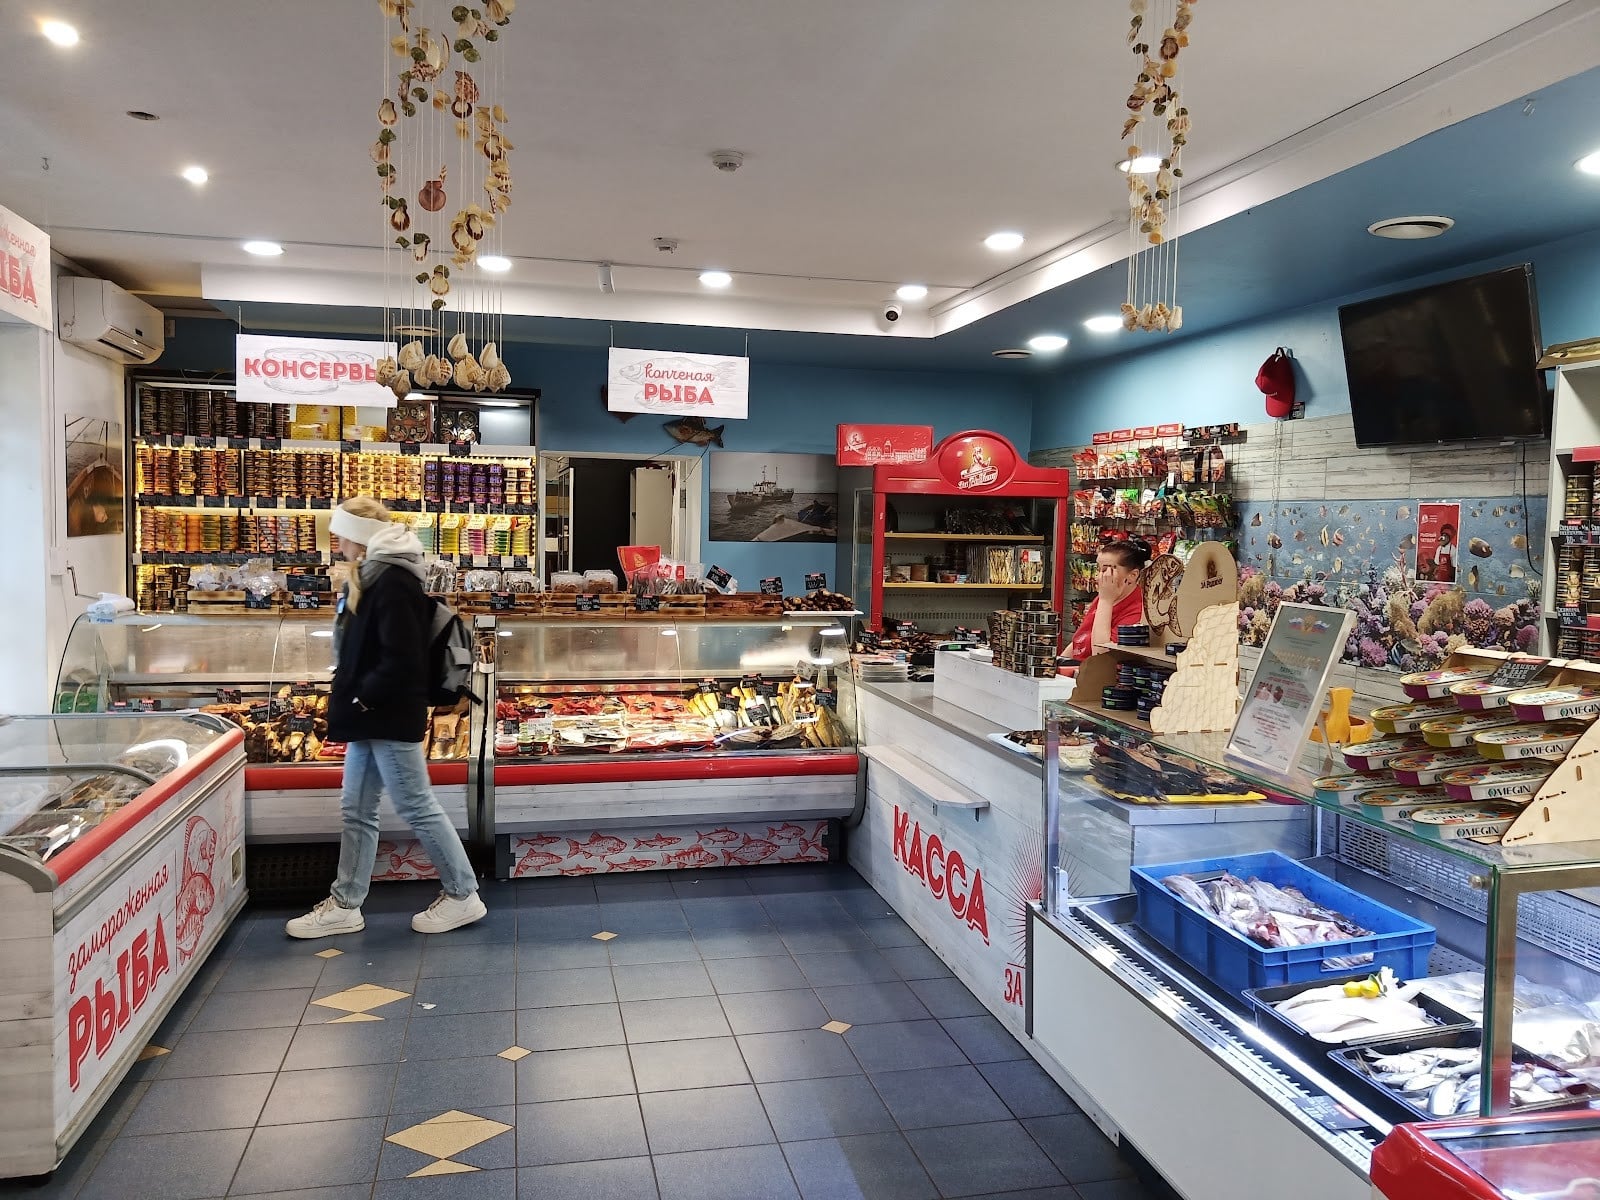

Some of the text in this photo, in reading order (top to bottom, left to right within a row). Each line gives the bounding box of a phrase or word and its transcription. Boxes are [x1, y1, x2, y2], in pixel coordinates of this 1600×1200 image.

[644, 362, 715, 382] копченая
[644, 383, 715, 405] РЫБА
[1520, 744, 1564, 757] OMEGIN
[1487, 785, 1531, 797] OMEGIN
[1456, 826, 1499, 838] OMEGIN
[893, 804, 990, 947] КАССА
[68, 863, 169, 995] замороженная
[1004, 968, 1024, 1008] ЗА
[68, 912, 170, 1093] РЫБА
